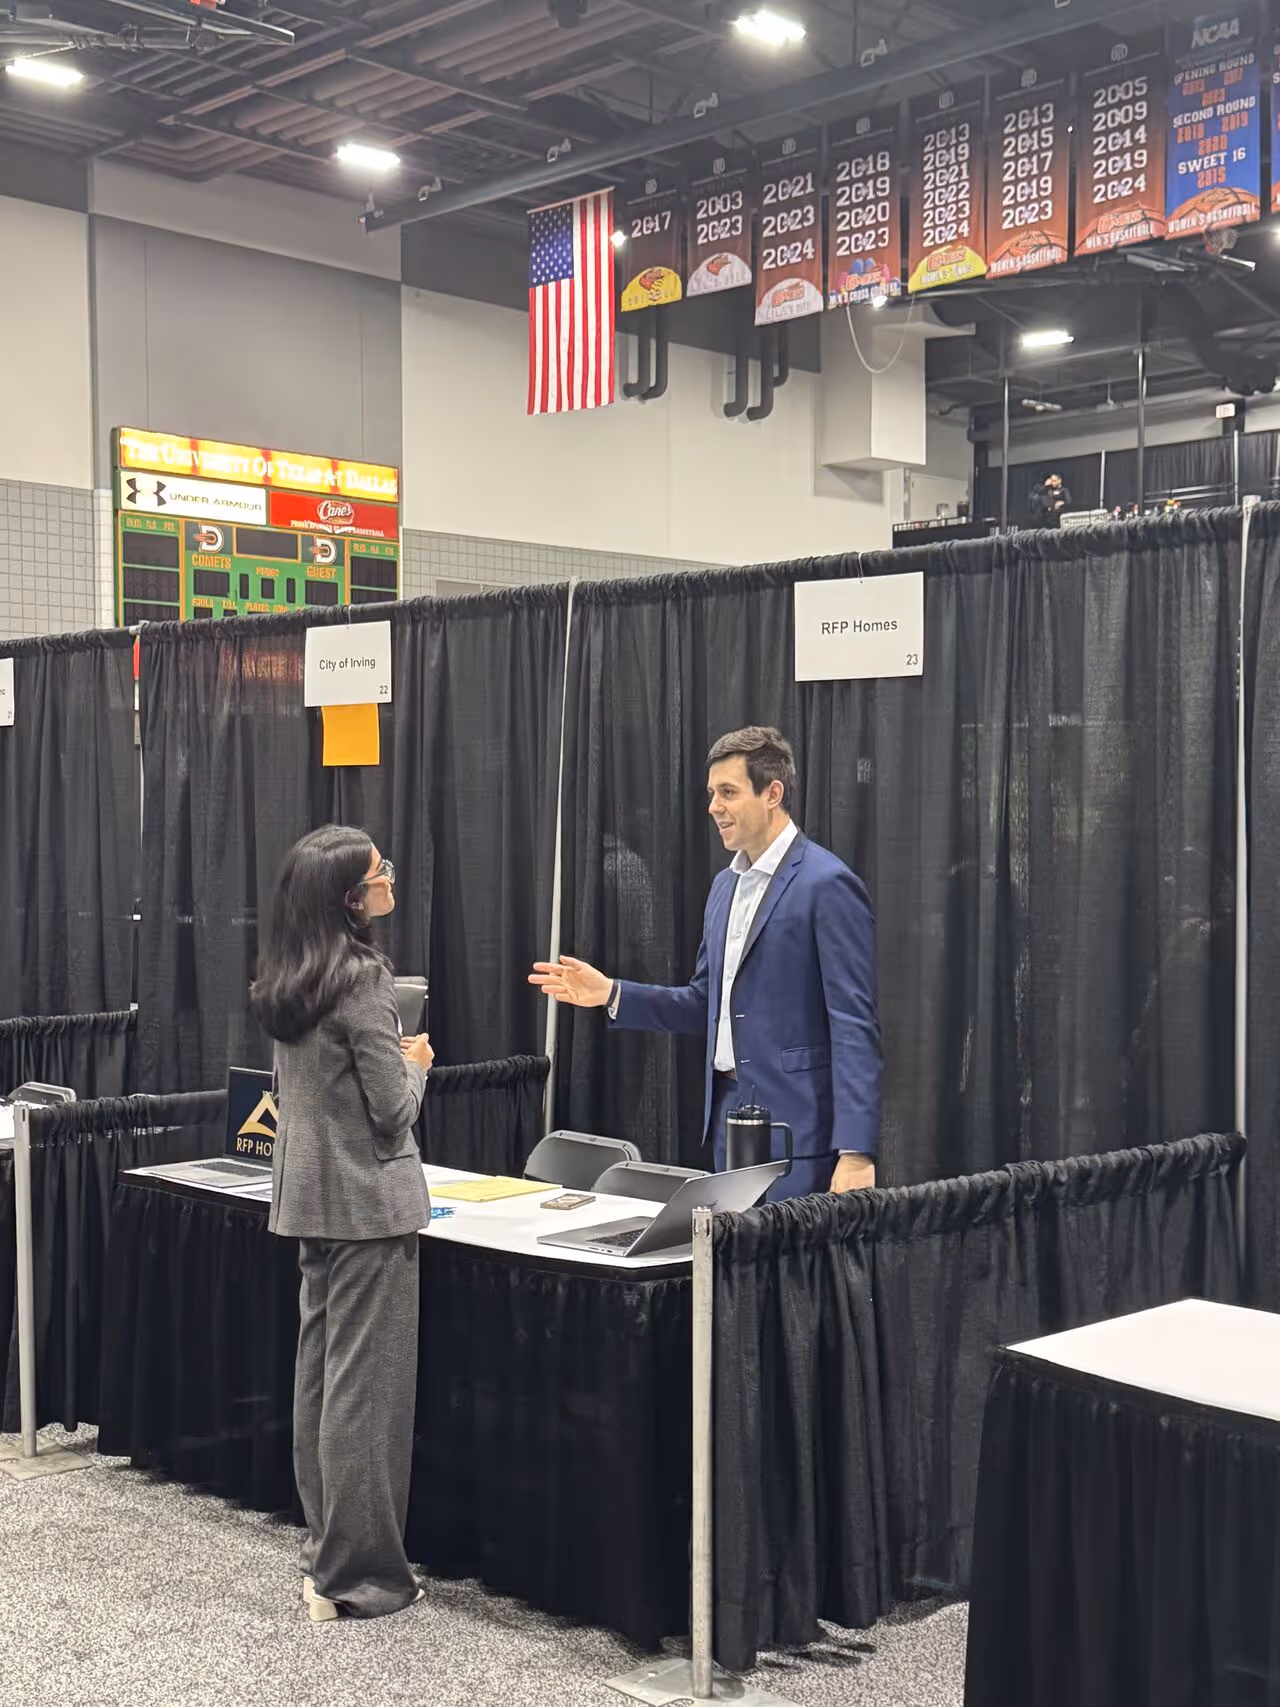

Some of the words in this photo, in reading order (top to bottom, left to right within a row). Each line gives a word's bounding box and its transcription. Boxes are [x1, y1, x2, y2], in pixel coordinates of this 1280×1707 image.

[1191, 18, 1239, 49] NCAA
[1093, 76, 1148, 108] 2005
[1003, 103, 1054, 134] 2013
[1093, 101, 1147, 132] 2009
[1173, 107, 1214, 128] SECOND
[1216, 96, 1256, 116] ROUND
[924, 123, 970, 152] 2013
[1003, 127, 1054, 158] 2015
[1093, 125, 1147, 155] 2014
[836, 151, 890, 182] 2018
[923, 143, 969, 172] 2019
[1002, 151, 1053, 182] 2017
[1093, 149, 1147, 179] 2019
[1178, 152, 1227, 174] SWEET
[1233, 147, 1246, 162] 16
[763, 172, 815, 206] 2021
[836, 176, 890, 207] 2019
[923, 162, 970, 191] 2021
[1002, 175, 1052, 206] 2019
[1093, 173, 1146, 204] 2024
[696, 190, 743, 220] 2003
[923, 181, 970, 210] 2022
[631, 210, 672, 239] 2017
[762, 204, 815, 238] 2023
[836, 201, 890, 232] 2020
[923, 200, 970, 229] 2023
[1002, 200, 1053, 230] 2023
[697, 215, 743, 245] 2023
[836, 227, 889, 257] 2023
[922, 219, 970, 248] 2024
[762, 238, 815, 270] 2024
[169, 493, 209, 505] UNDER
[191, 554, 231, 569] COMETS
[306, 565, 336, 579] GUEST
[821, 621, 848, 635] RFP
[853, 620, 898, 632] Homes
[319, 659, 336, 672] City
[339, 658, 348, 669] of
[350, 657, 376, 669] Irving
[906, 654, 918, 665] 23
[379, 685, 389, 694] 22
[236, 1137, 253, 1153] RFP
